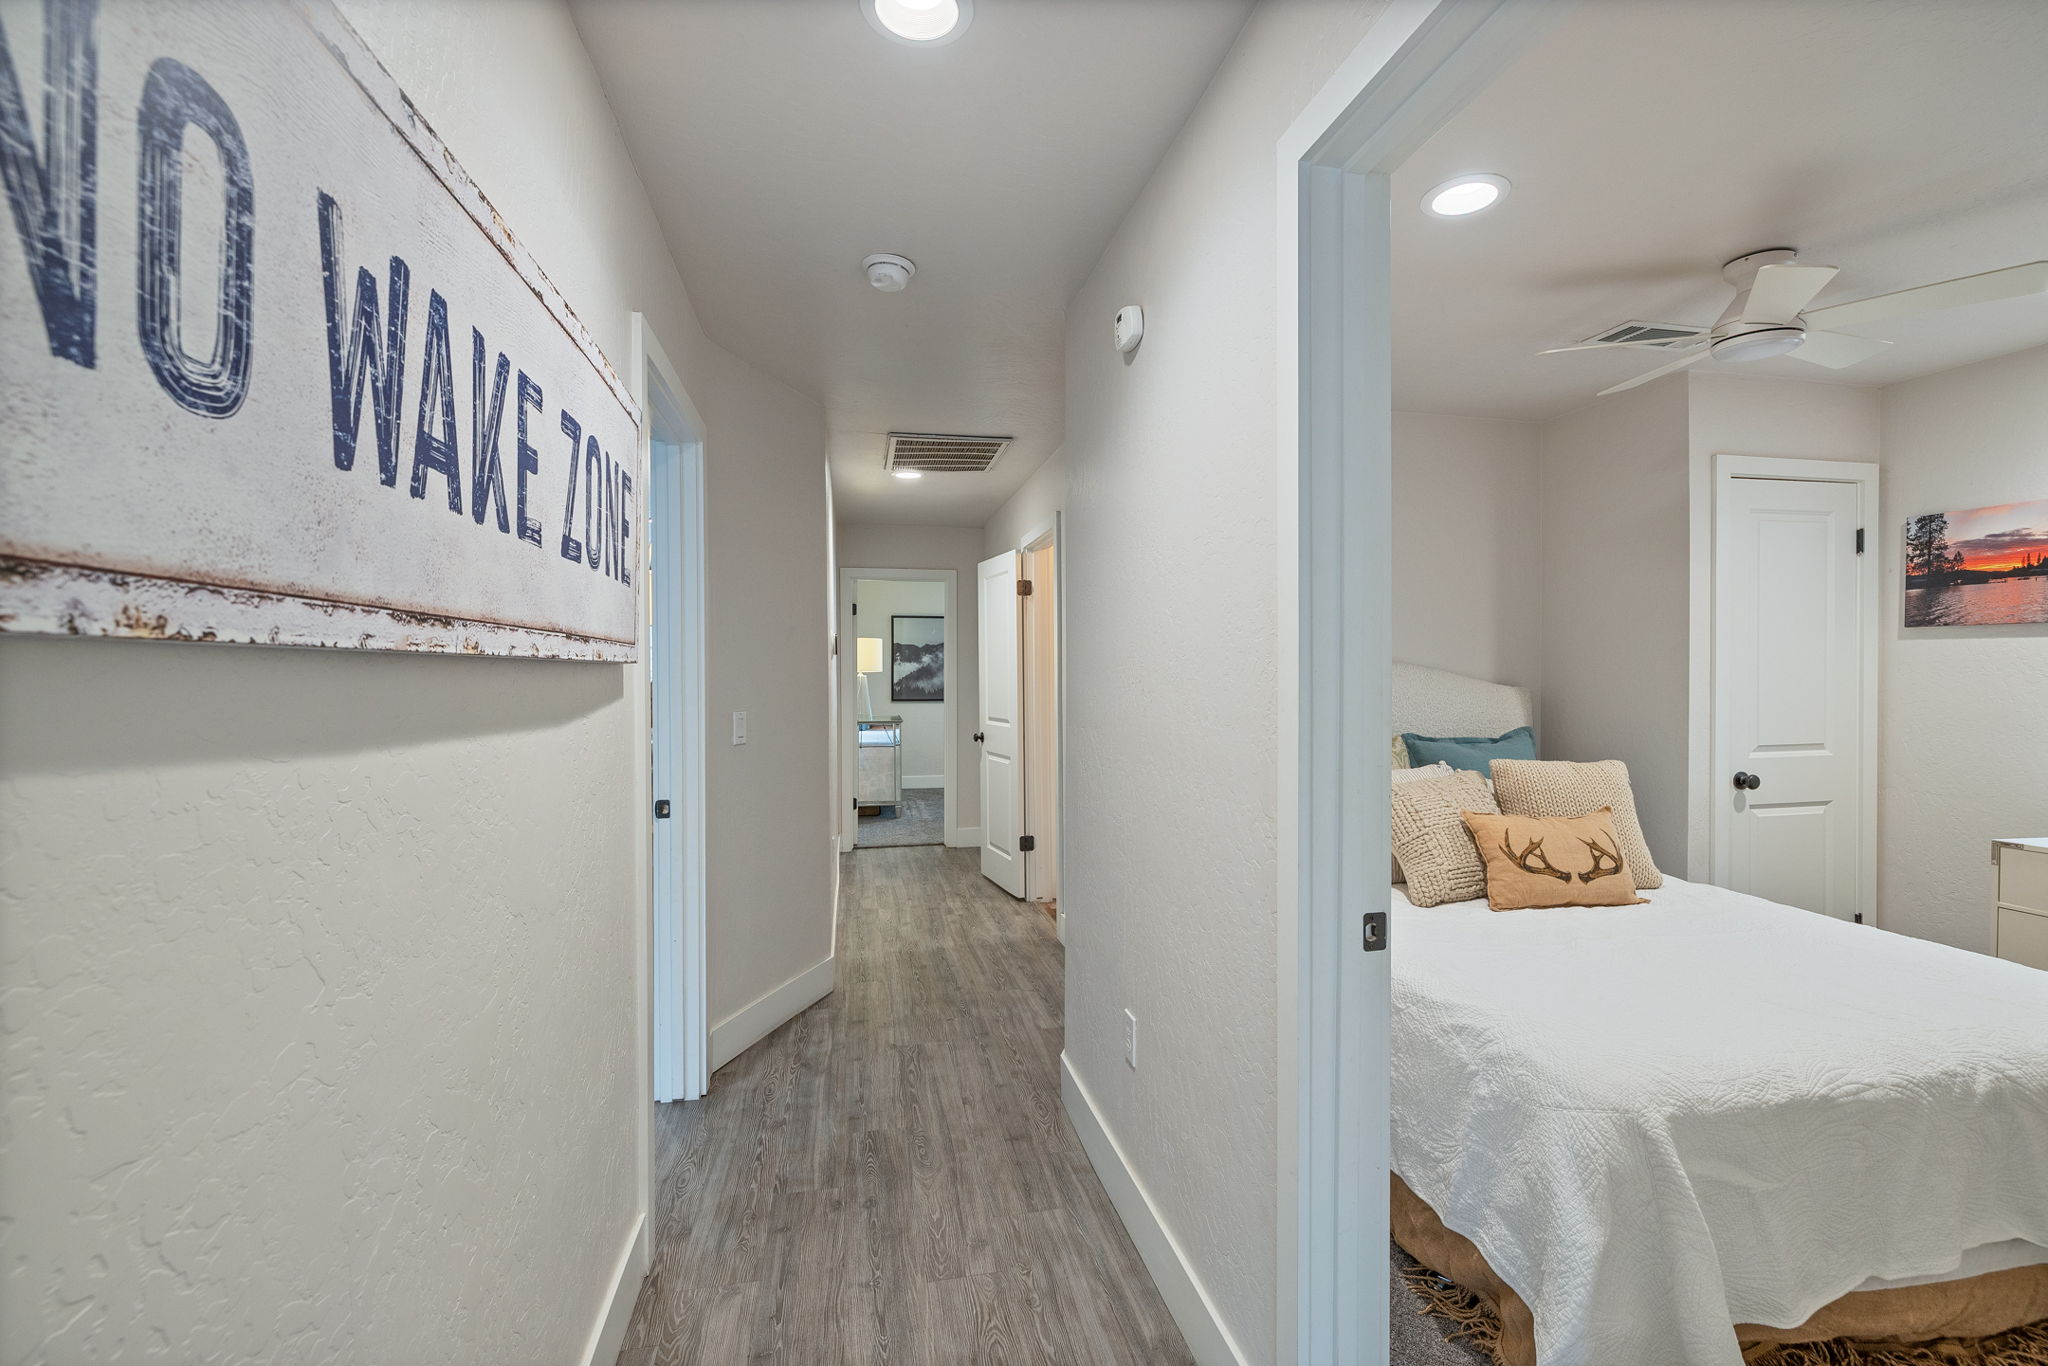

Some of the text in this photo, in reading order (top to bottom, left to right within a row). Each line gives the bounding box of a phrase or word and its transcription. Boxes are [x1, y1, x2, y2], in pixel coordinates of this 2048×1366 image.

[0, 0, 633, 588] NO WAKE ZONE
